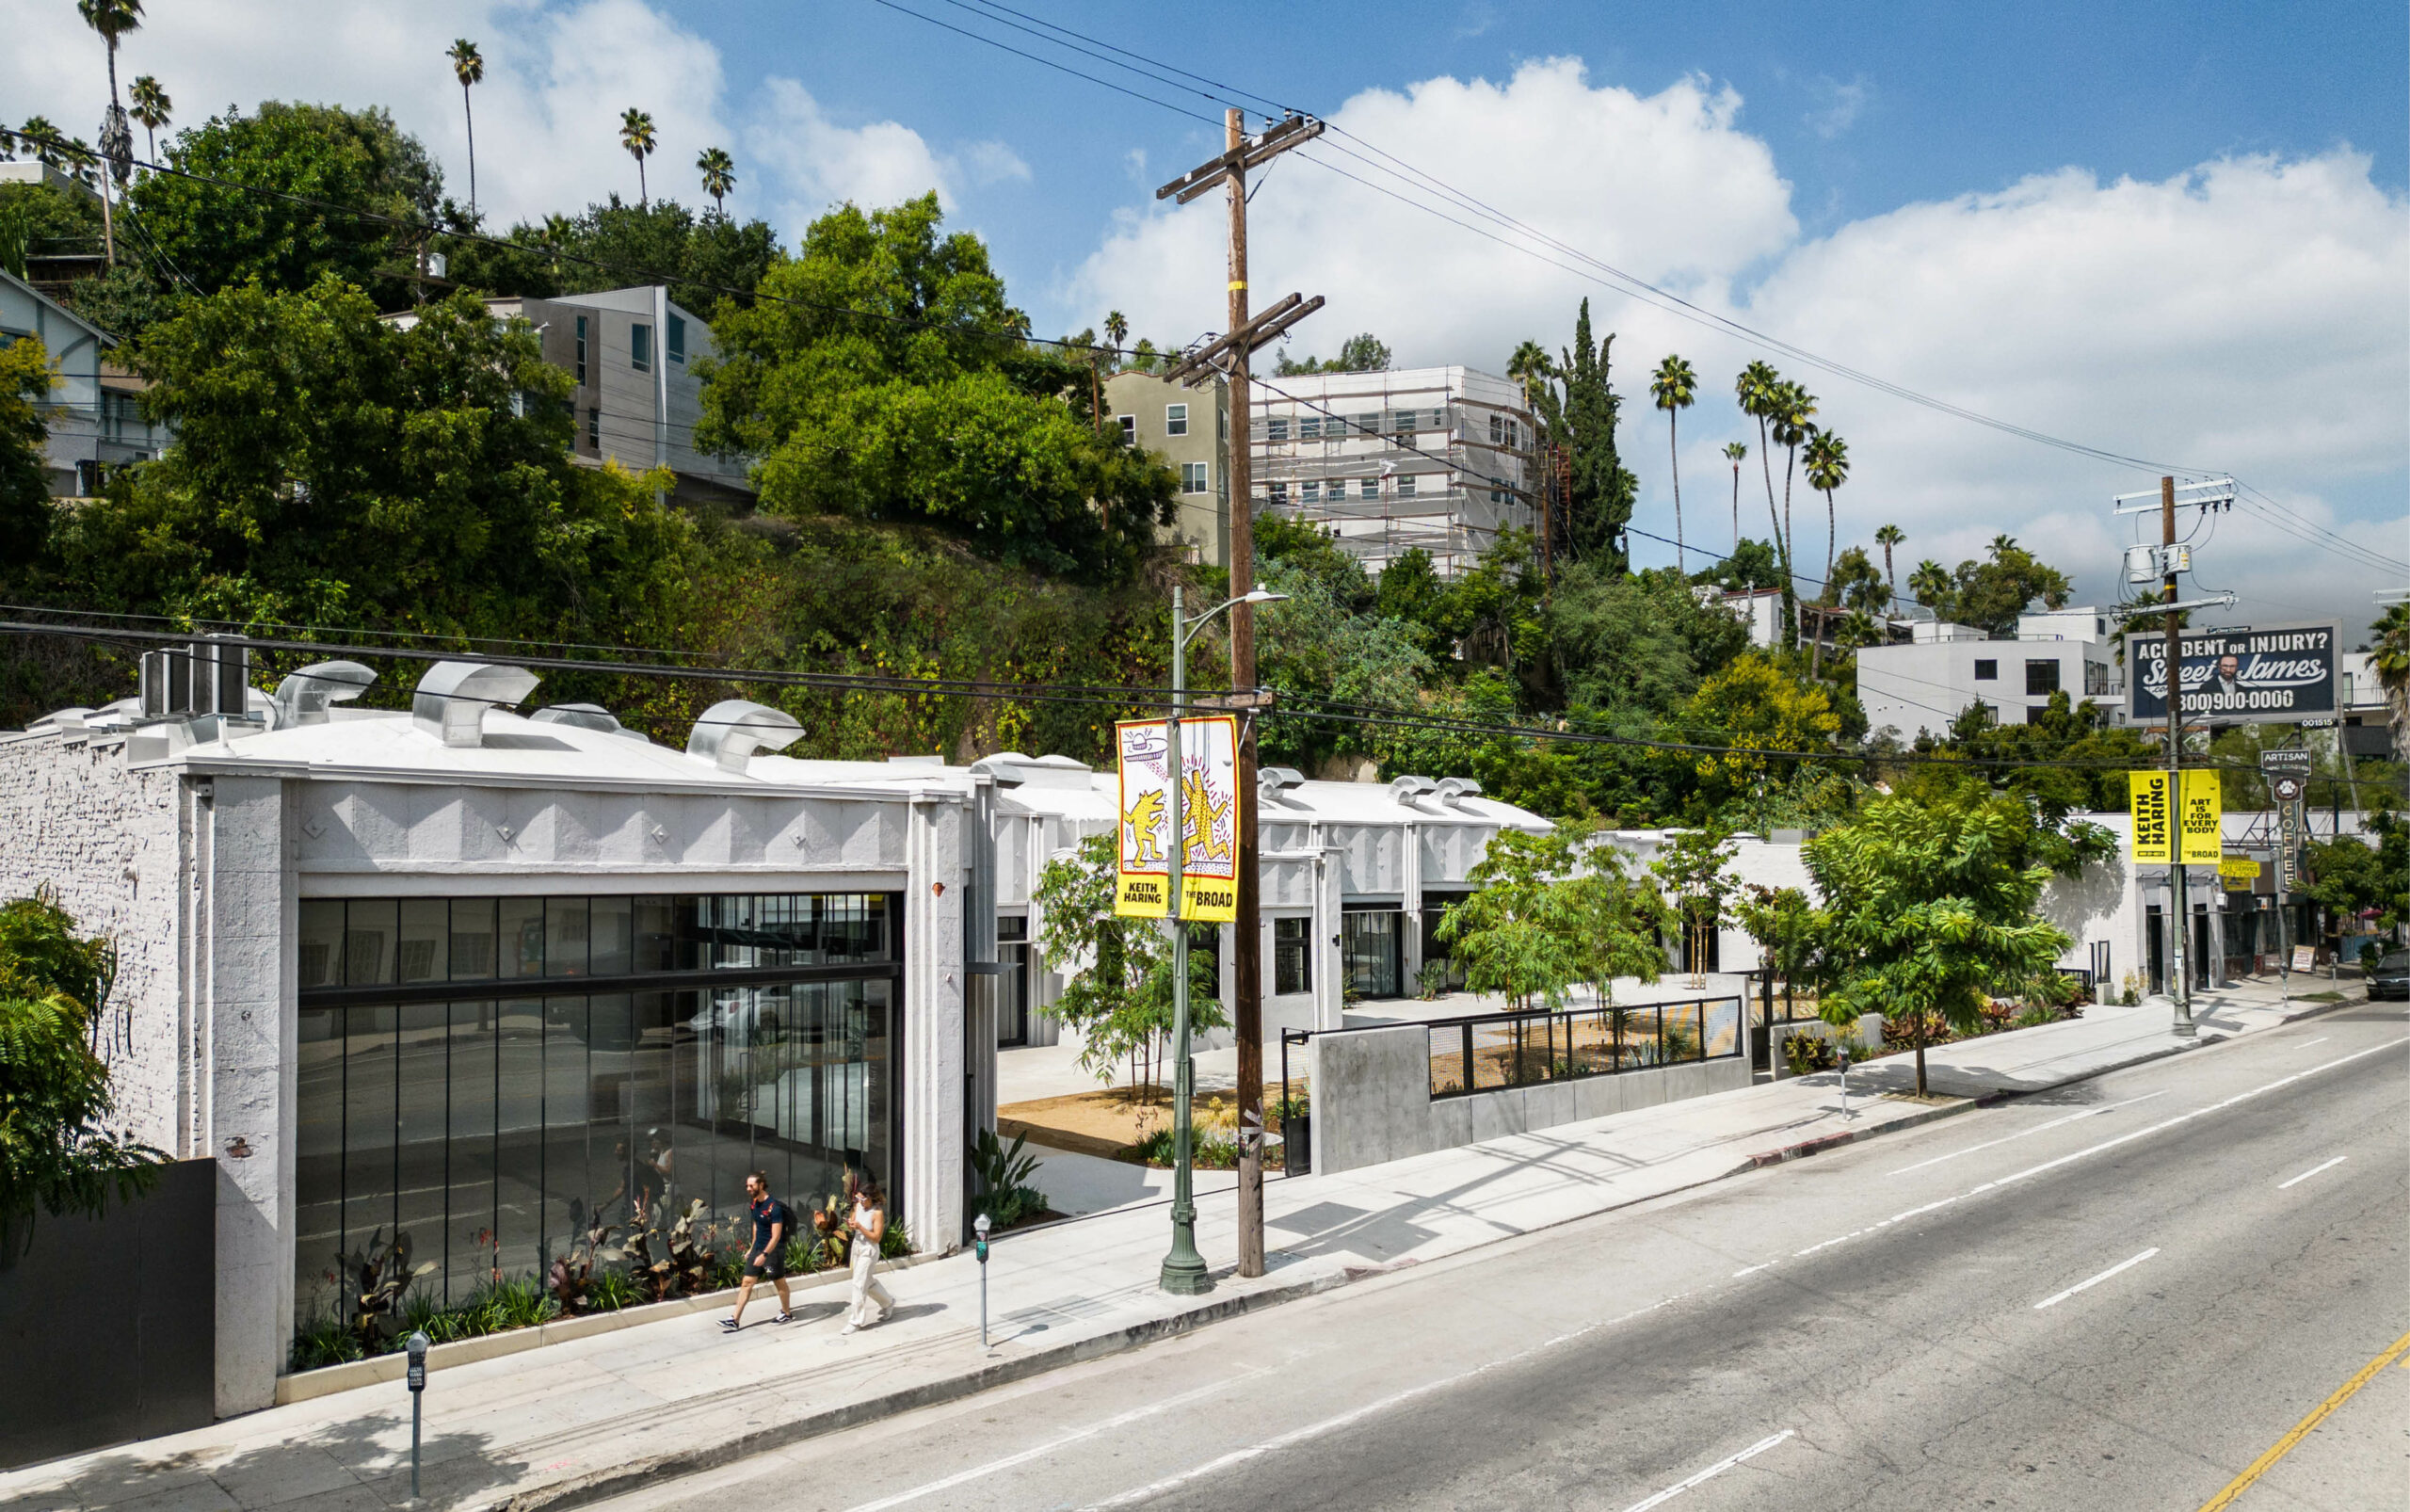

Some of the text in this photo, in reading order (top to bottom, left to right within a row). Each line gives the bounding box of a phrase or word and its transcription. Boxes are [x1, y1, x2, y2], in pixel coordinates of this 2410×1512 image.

[2139, 632, 2328, 659] ACDENT OR INJURY?
[2236, 653, 2324, 681] James
[2302, 718, 2333, 727] 001515
[2264, 752, 2308, 762] ARTISAN
[2136, 795, 2150, 844] KEITH
[2149, 779, 2165, 844] HARING
[2282, 805, 2294, 885] COFFEE
[1129, 882, 1158, 893] KEITH
[1124, 893, 1162, 904] HARING
[1197, 892, 1233, 908] BROAD
